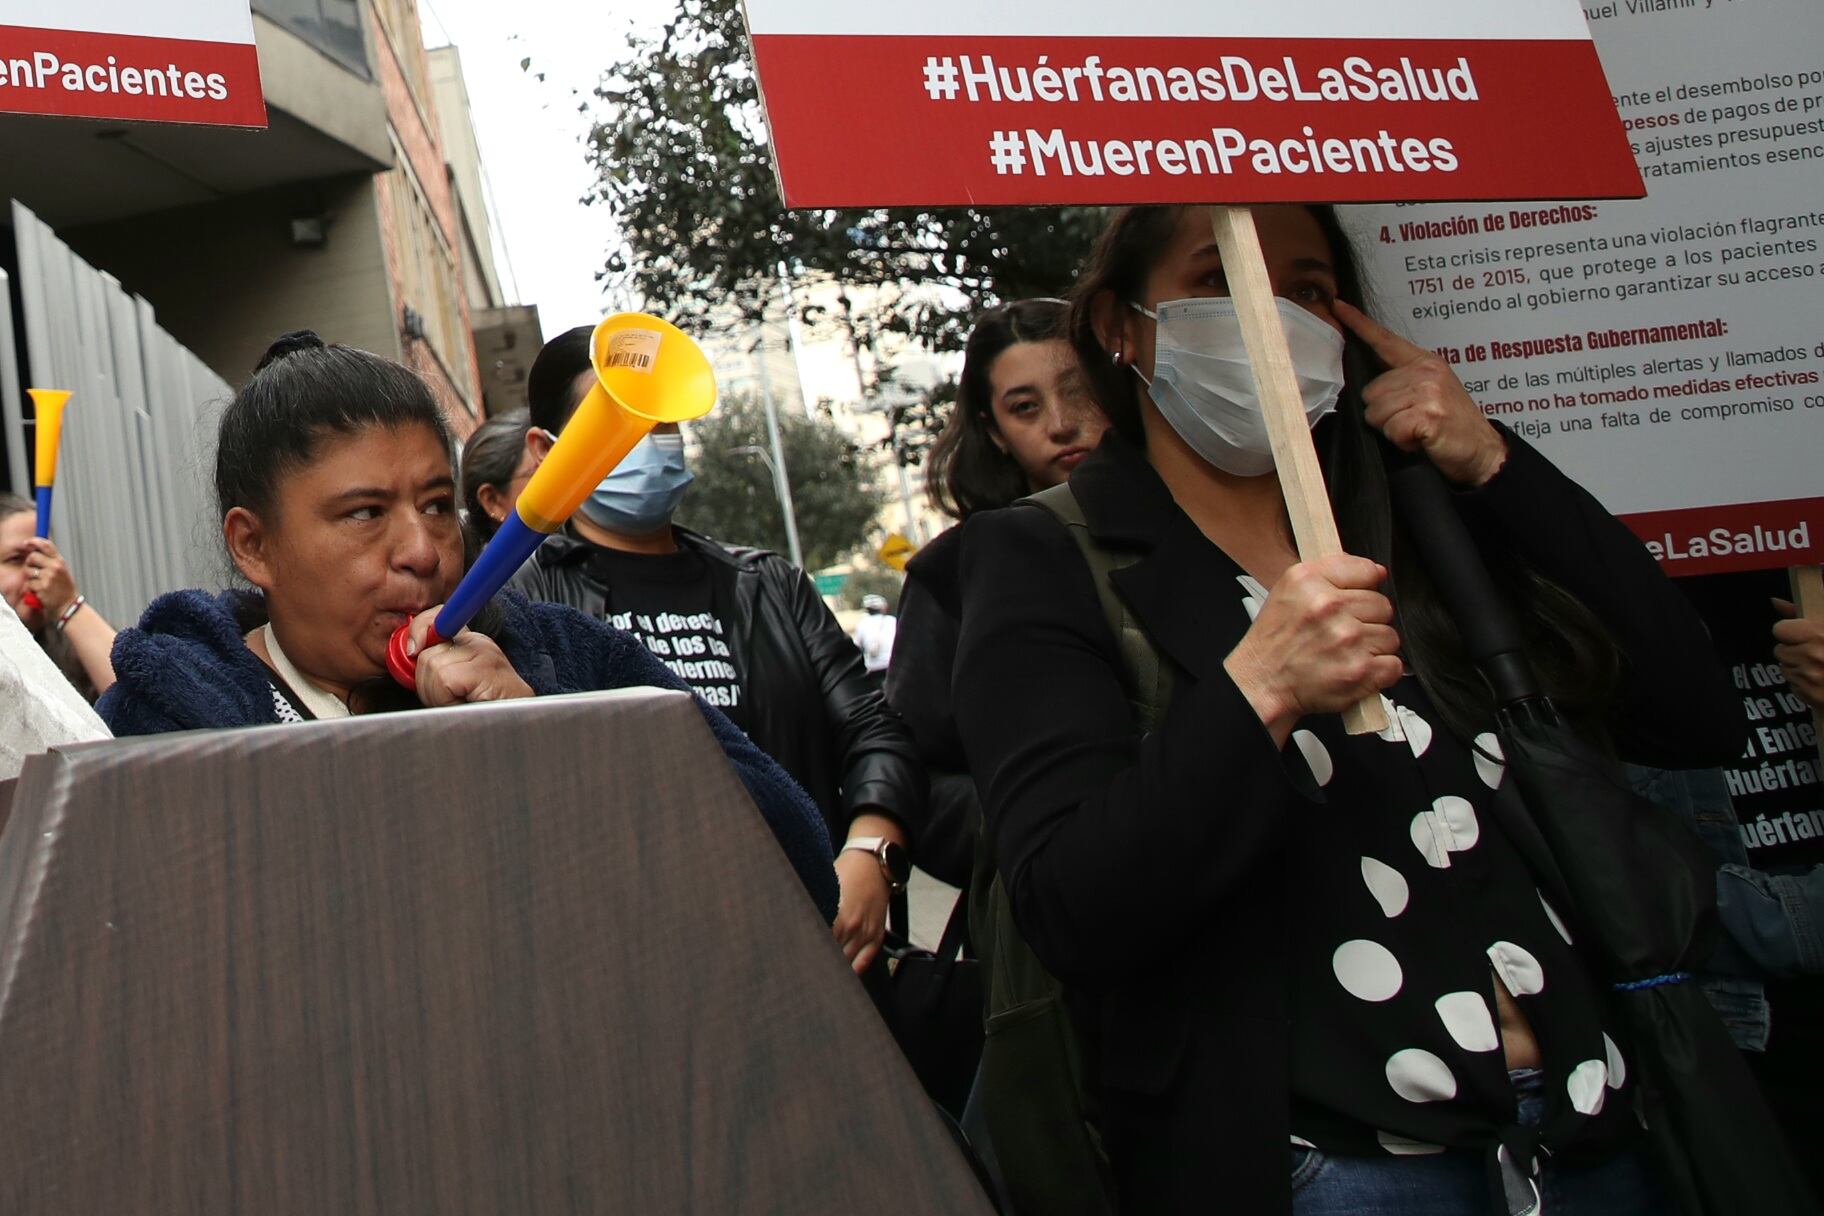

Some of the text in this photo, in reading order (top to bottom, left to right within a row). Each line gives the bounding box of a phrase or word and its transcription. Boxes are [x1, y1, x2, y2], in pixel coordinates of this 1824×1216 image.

[922, 55, 1479, 102] #HuérfanasDeLaSalud
[988, 125, 1458, 176] #MuerenPacientes
[1379, 204, 1598, 245] 4. Violación de Derechos:
[1404, 221, 1737, 273] Esta crisis representa una violación
[1464, 318, 1730, 364] de Respuesta Gubernamental:
[1527, 370, 1820, 411] no ha tomado medidas efectivas
[671, 635, 706, 656] los
